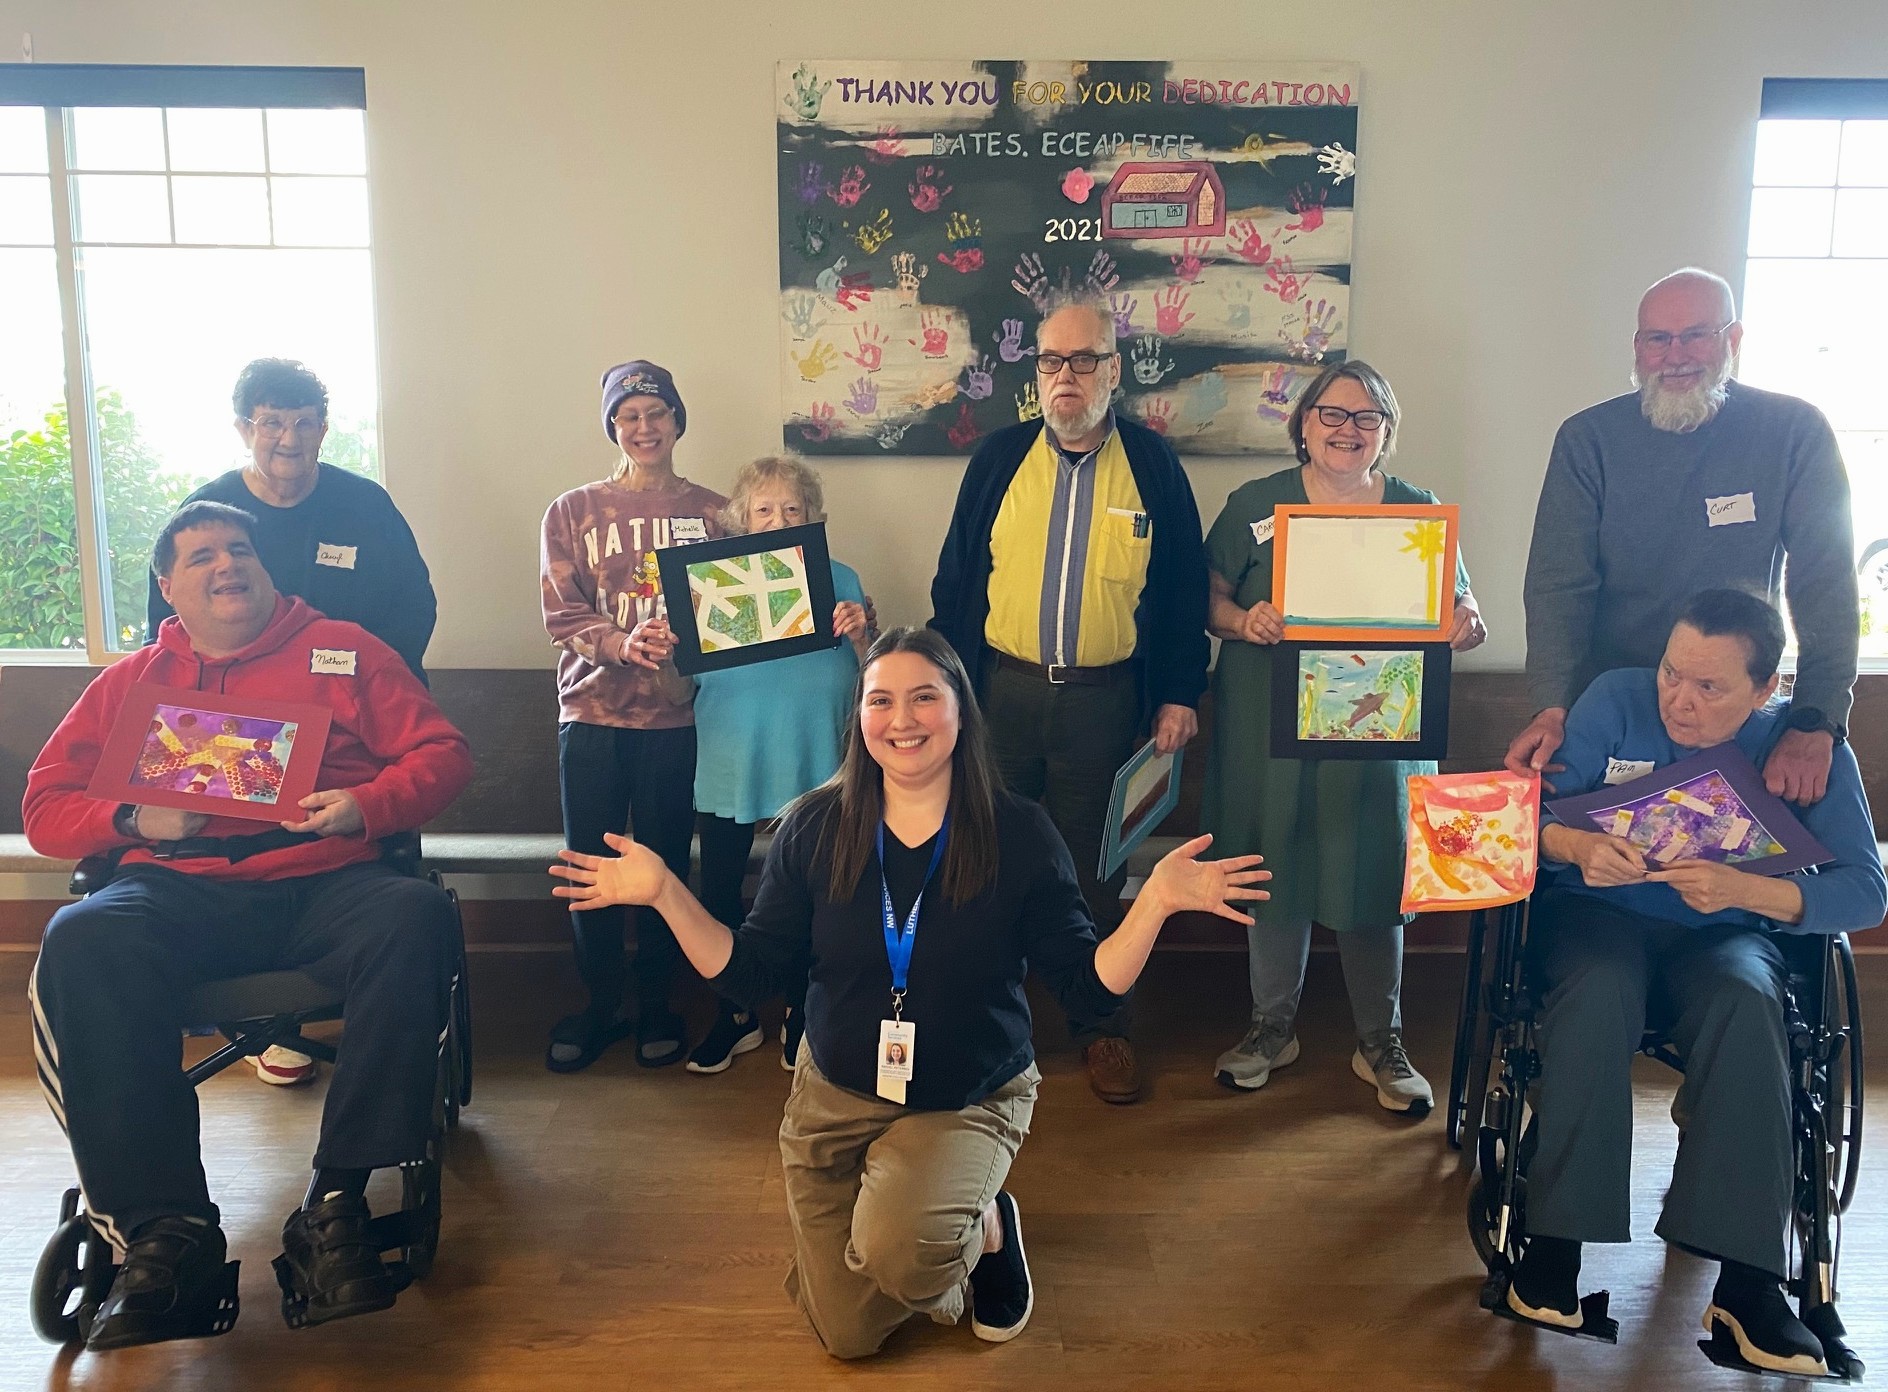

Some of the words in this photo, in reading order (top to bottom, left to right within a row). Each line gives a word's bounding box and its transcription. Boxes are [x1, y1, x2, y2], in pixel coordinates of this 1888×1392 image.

[837, 78, 934, 106] THANK
[941, 80, 1000, 106] YOU
[1012, 80, 1067, 105] FOR
[1078, 80, 1152, 105] YOUR
[1163, 79, 1351, 107] DEDICATION
[932, 132, 1028, 157] BATES.
[1041, 132, 1125, 157] ECEAP
[1131, 133, 1196, 159] FIFE
[1044, 218, 1103, 243] 2021
[315, 653, 349, 666] Nathan
[886, 913, 895, 929] NW
